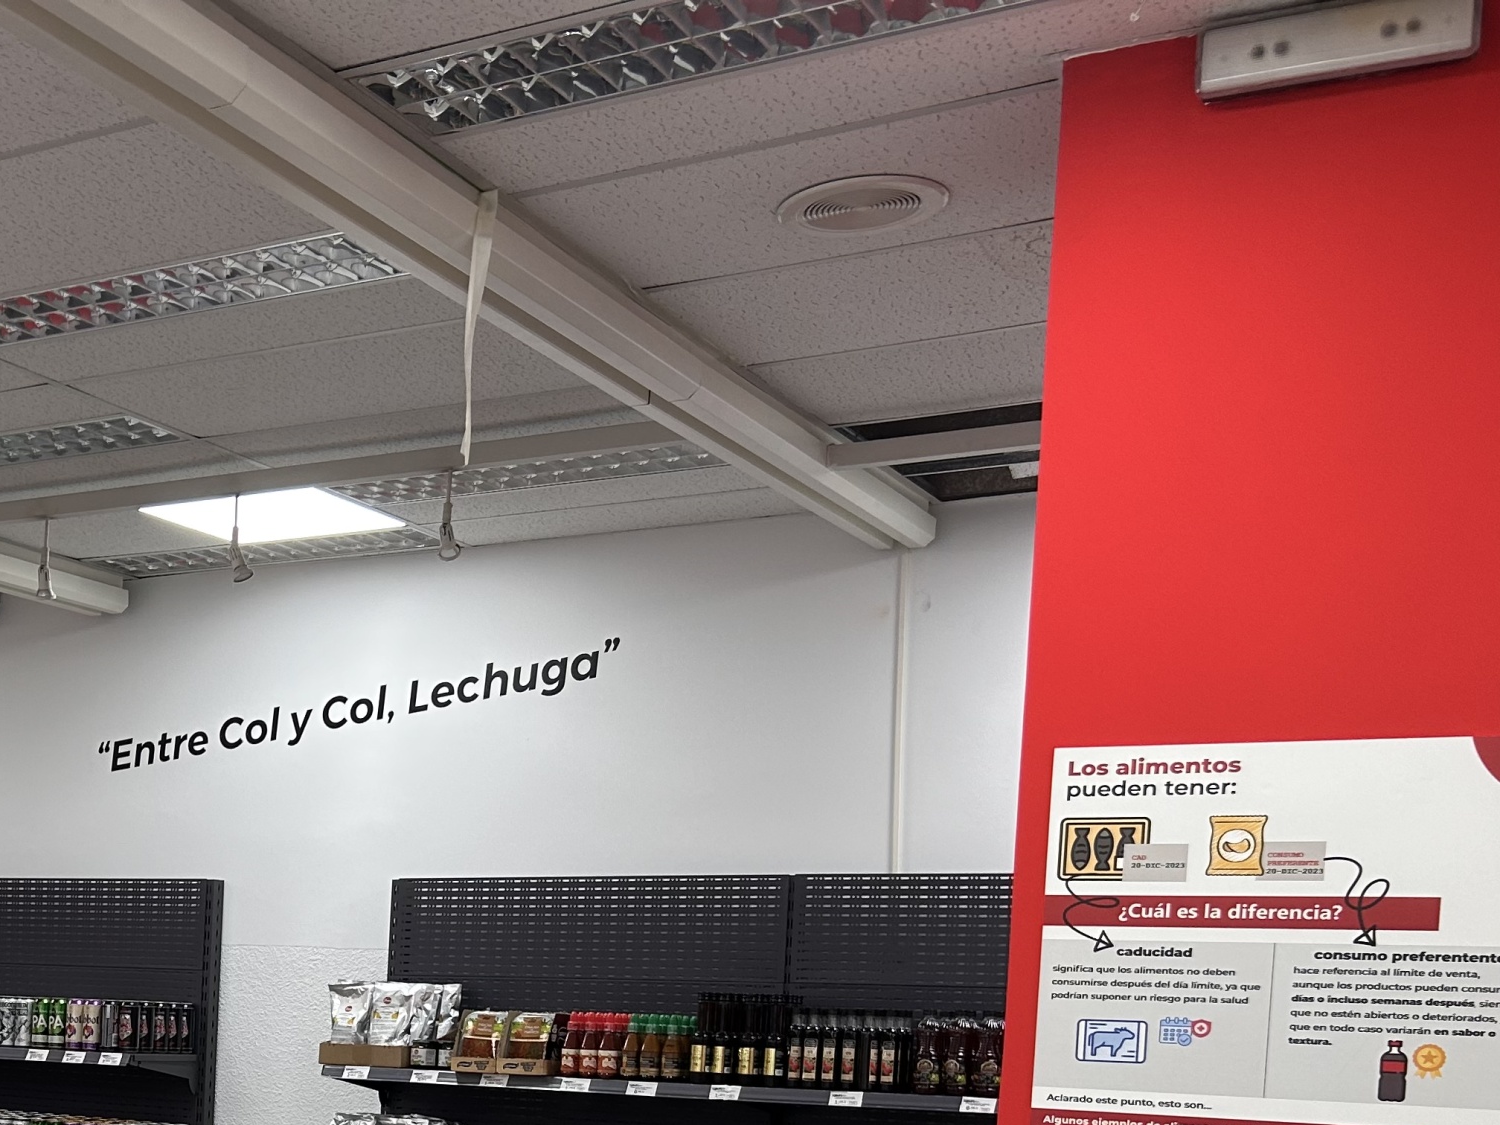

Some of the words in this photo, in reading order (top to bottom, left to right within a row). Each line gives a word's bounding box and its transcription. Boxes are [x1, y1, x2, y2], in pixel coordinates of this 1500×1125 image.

[98, 726, 208, 772] “Entre
[219, 706, 281, 750] Col
[288, 709, 312, 746] y
[322, 685, 395, 730] Col,
[408, 638, 620, 715] Lechuga”
[1068, 762, 1108, 776] Los
[1116, 758, 1241, 775] alimentos
[1067, 780, 1156, 801] pueden
[1165, 782, 1236, 795] tener:
[1119, 903, 1171, 921] ¿Cuál
[1177, 908, 1198, 918] es
[1204, 904, 1221, 918] la
[1228, 904, 1342, 920] diferencia?
[1117, 947, 1192, 957] caducidad
[1314, 952, 1387, 961] consumo
[1053, 965, 1093, 973] significa
[1202, 968, 1235, 976] deben
[1294, 966, 1319, 974] hace
[1446, 971, 1480, 979] venta,
[1110, 980, 1152, 988] después
[1150, 994, 1181, 1003] riesgo
[1047, 1094, 1093, 1103] Aclarado
[1043, 1116, 1089, 1125] Algunos
